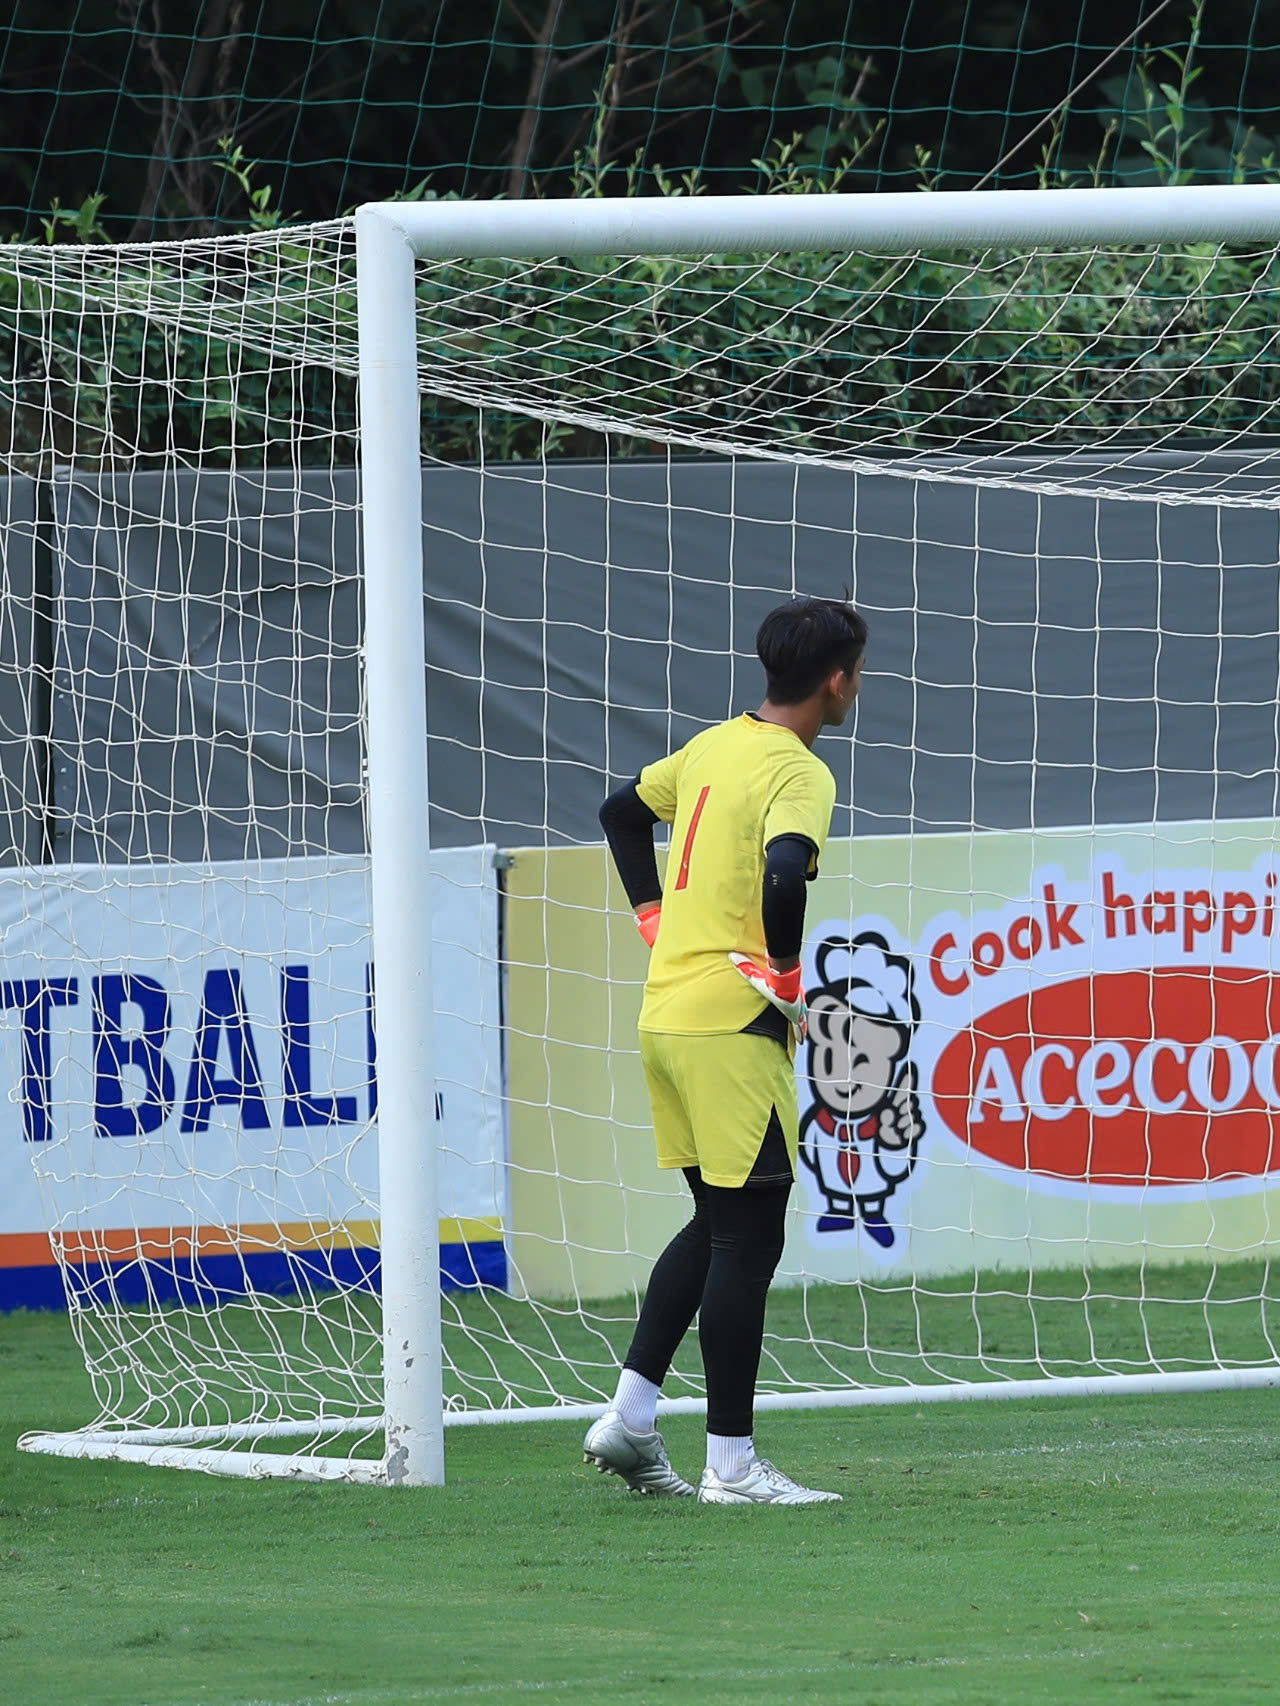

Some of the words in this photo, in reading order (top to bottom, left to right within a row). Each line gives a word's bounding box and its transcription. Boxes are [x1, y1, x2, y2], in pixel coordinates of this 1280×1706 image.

[674, 784, 712, 891] 1
[929, 883, 1085, 996] Cook
[0, 961, 444, 1142] TBAL
